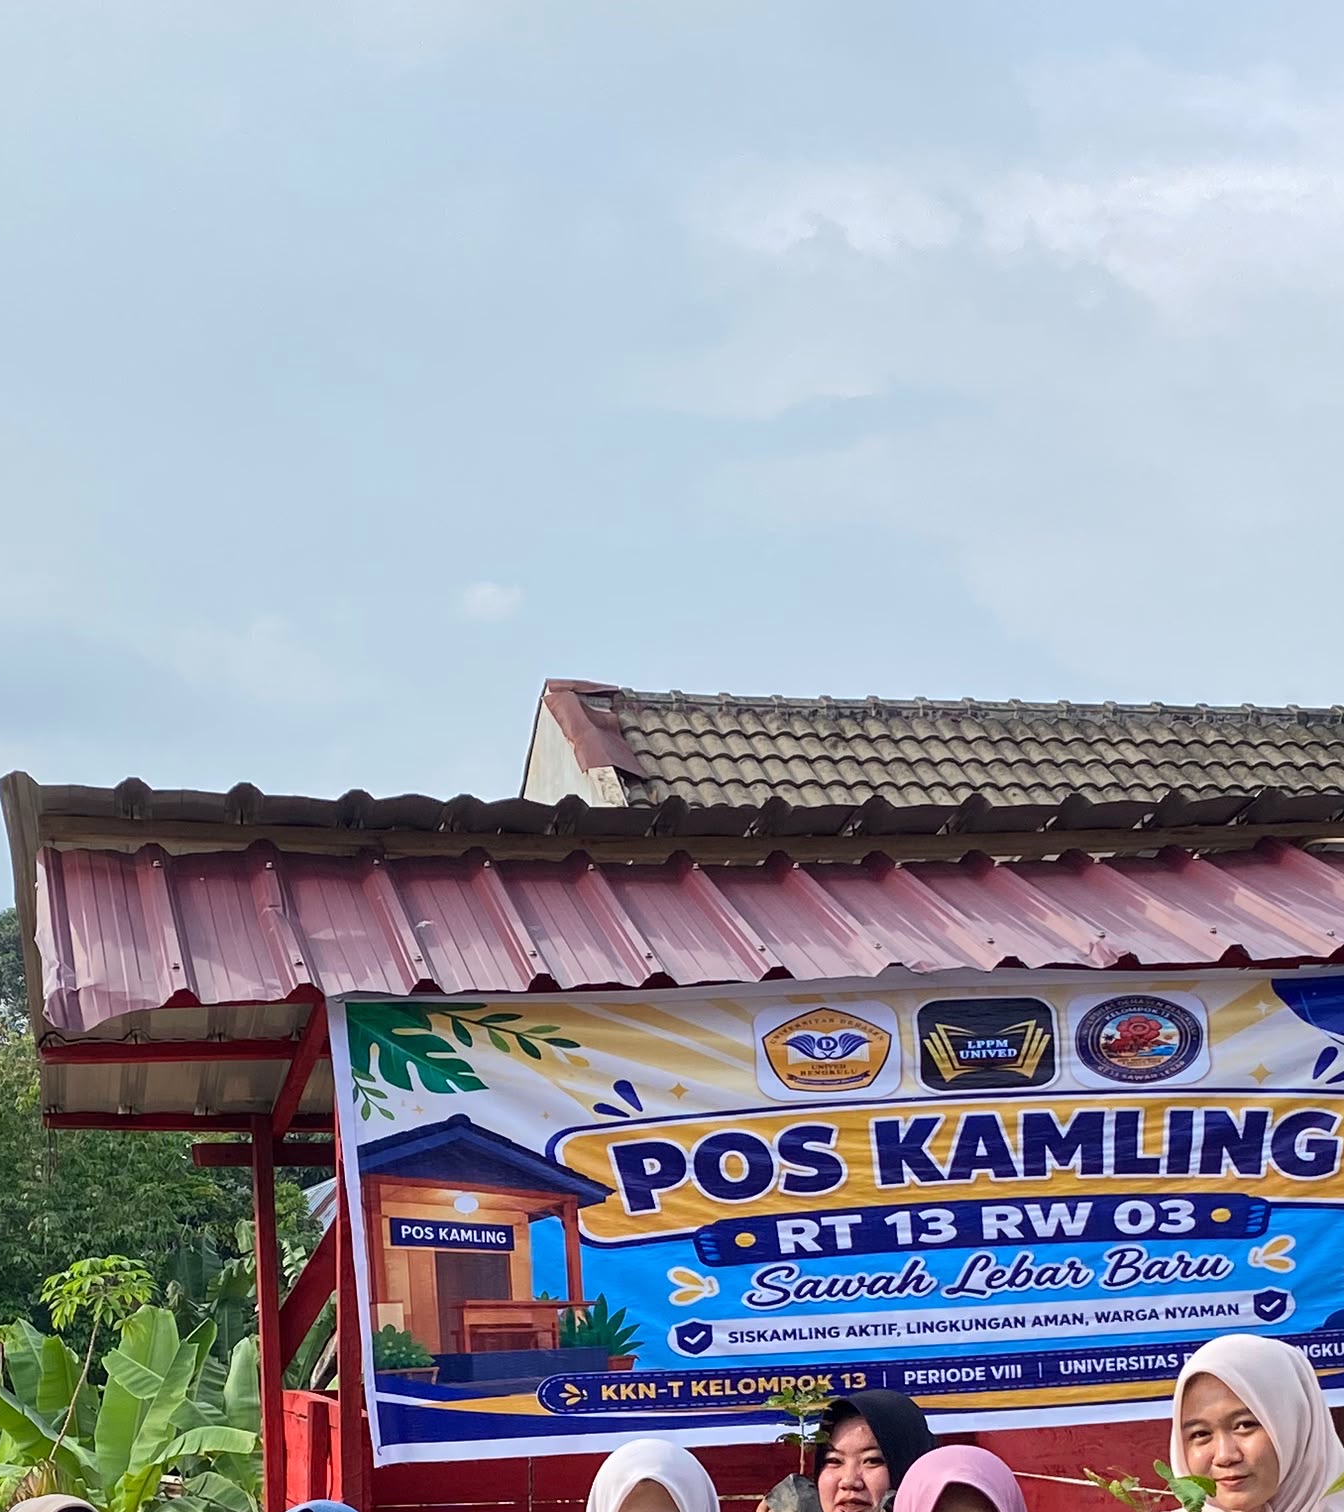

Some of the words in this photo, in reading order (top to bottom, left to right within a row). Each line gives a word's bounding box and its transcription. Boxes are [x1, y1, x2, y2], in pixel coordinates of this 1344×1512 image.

[821, 1039, 834, 1049] D
[959, 1048, 1018, 1059] UNIVED
[967, 1039, 1009, 1049] LPPM
[610, 1122, 845, 1214] POS
[871, 1106, 1342, 1187] KAMLING
[400, 1225, 435, 1240] POS
[438, 1228, 507, 1244] KAMLING
[776, 1214, 862, 1255] RT
[884, 1208, 958, 1245] 13
[981, 1201, 1094, 1240] RW
[1113, 1199, 1196, 1235] 03
[745, 1258, 935, 1308] Sawah
[947, 1252, 1092, 1298] Lebar
[1101, 1247, 1231, 1288] Baru
[728, 1326, 840, 1344] SISKAMLING
[845, 1322, 902, 1338] AKTIF,
[906, 1316, 1026, 1335] LINGKUNGAN
[1031, 1312, 1090, 1328] AMAN,
[1094, 1308, 1160, 1324] WARGA
[1164, 1303, 1240, 1320] NYAMAN
[904, 1365, 986, 1385] PERIODE
[990, 1364, 1022, 1380] VIII
[1059, 1353, 1179, 1376] UNIVERSITAS
[601, 1380, 684, 1401] KKN-T
[691, 1373, 834, 1396] KELOMPOK
[839, 1372, 867, 1389] 13
